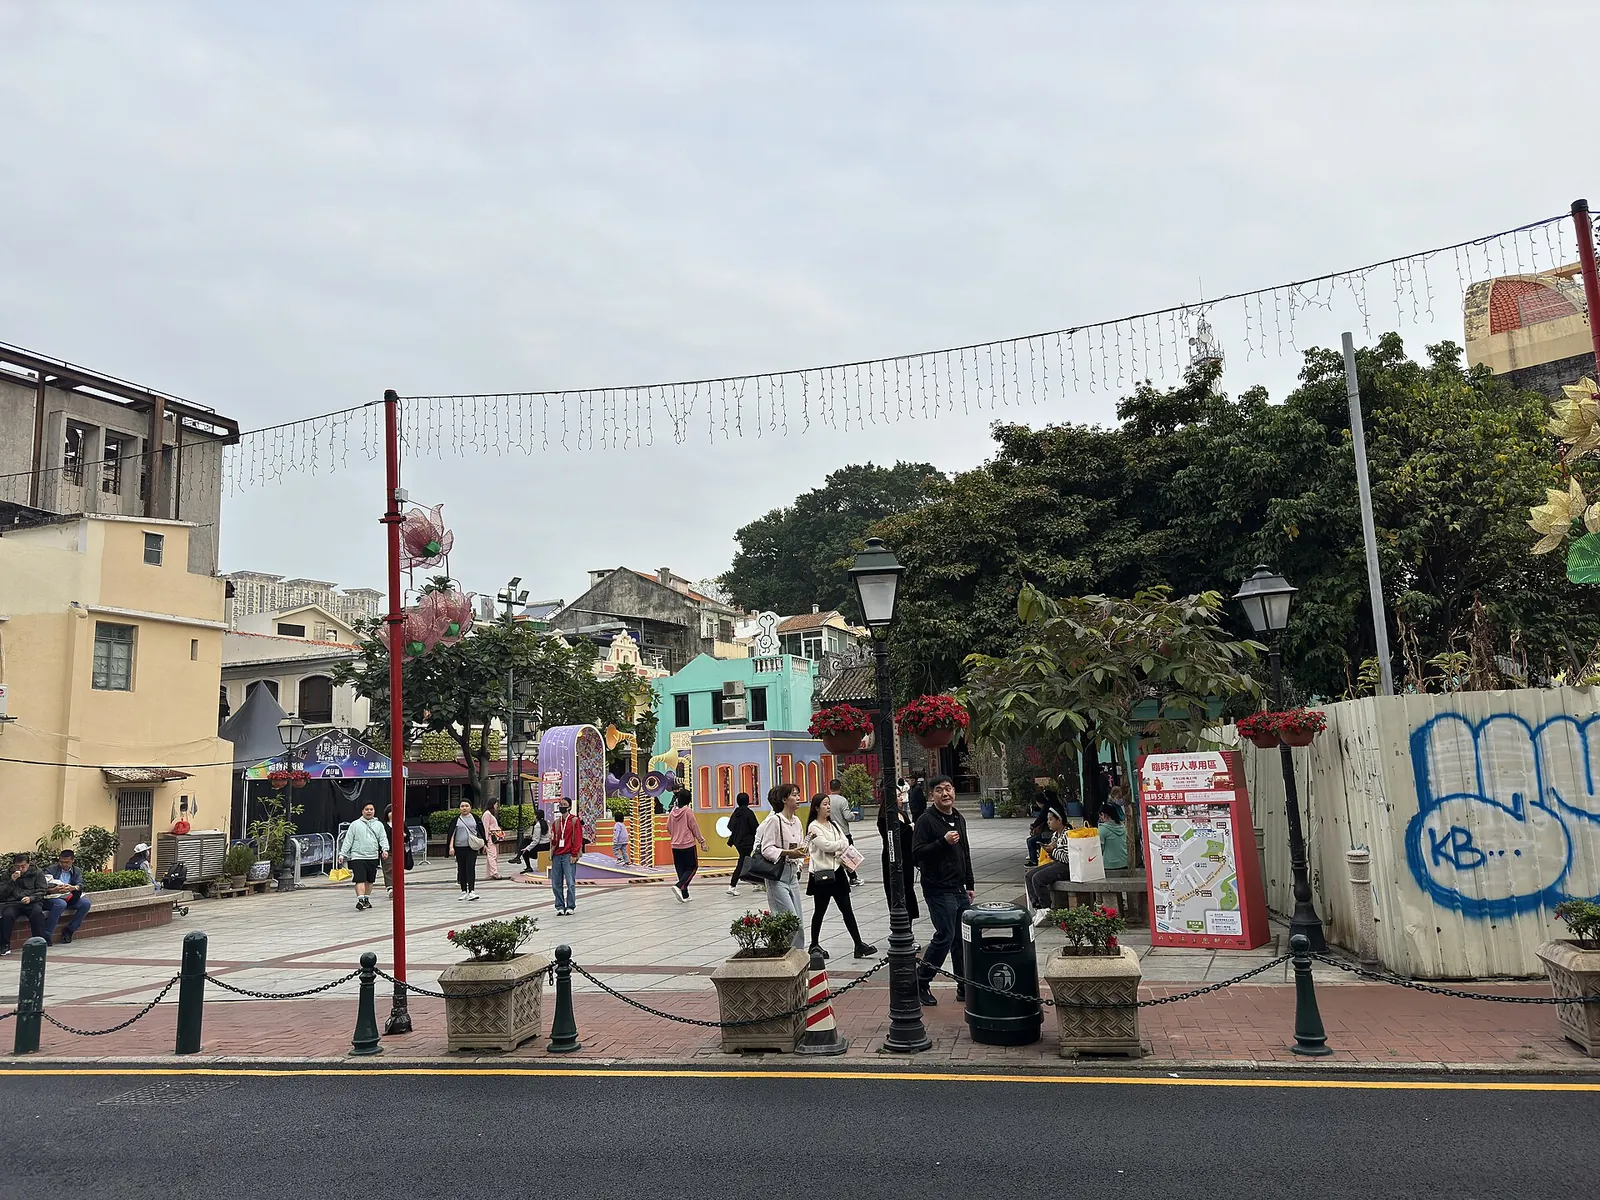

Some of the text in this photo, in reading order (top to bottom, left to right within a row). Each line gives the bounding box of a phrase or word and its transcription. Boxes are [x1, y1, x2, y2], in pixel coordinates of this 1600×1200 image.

[1151, 760, 1218, 771] 臨時行人專用區
